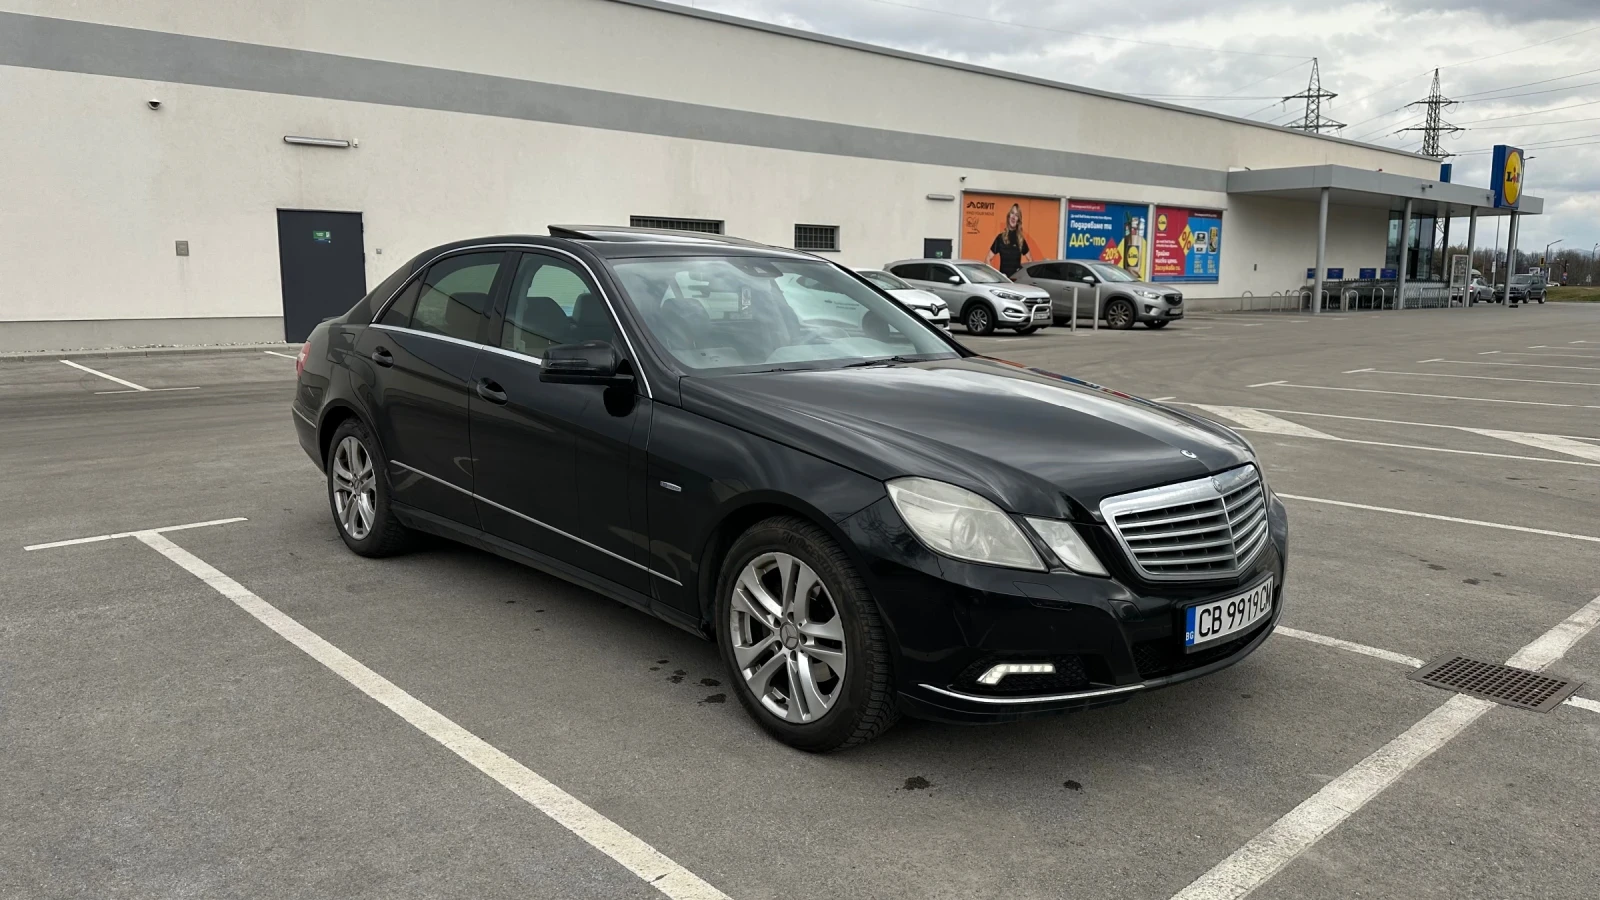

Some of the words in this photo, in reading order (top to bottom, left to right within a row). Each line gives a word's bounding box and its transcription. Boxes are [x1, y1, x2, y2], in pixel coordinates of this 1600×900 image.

[1199, 606, 1222, 637] CB
[1227, 591, 1259, 629] 9919
[1186, 631, 1194, 641] BG
